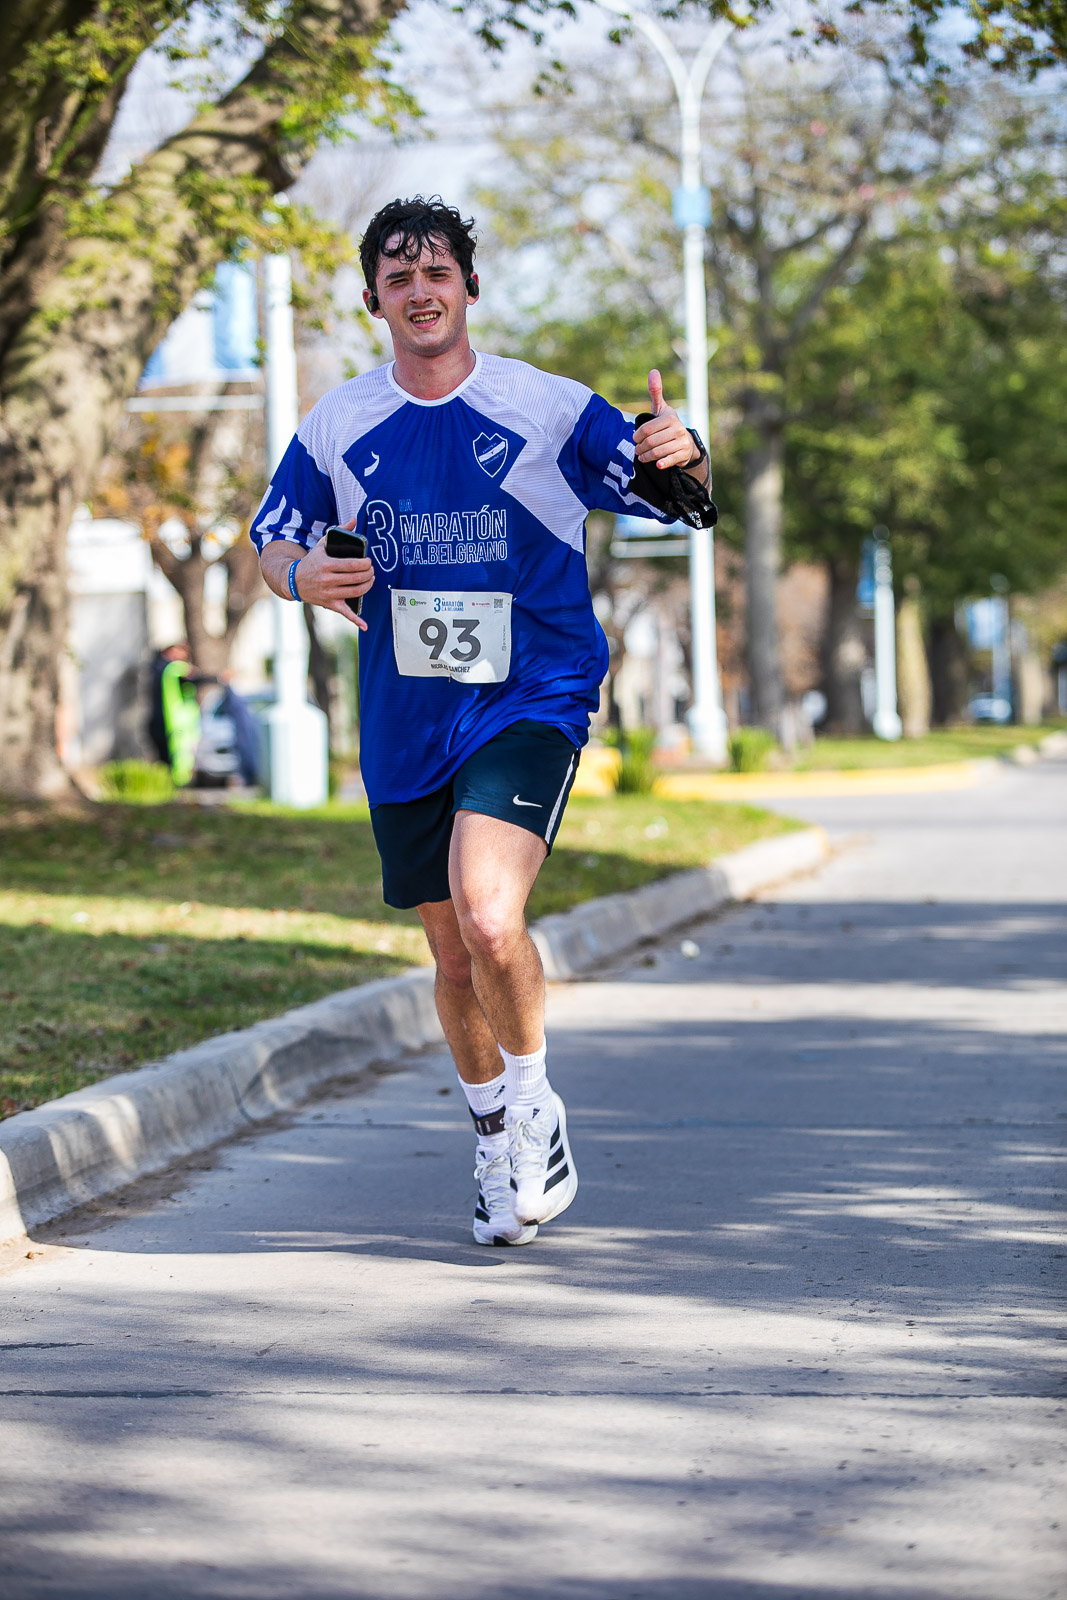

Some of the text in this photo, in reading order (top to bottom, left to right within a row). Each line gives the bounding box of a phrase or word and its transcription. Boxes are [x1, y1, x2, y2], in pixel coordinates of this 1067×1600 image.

[366, 499, 399, 572] 3
[399, 504, 507, 544] MARATÓN
[434, 598, 441, 612] 3
[419, 618, 481, 662] 93
